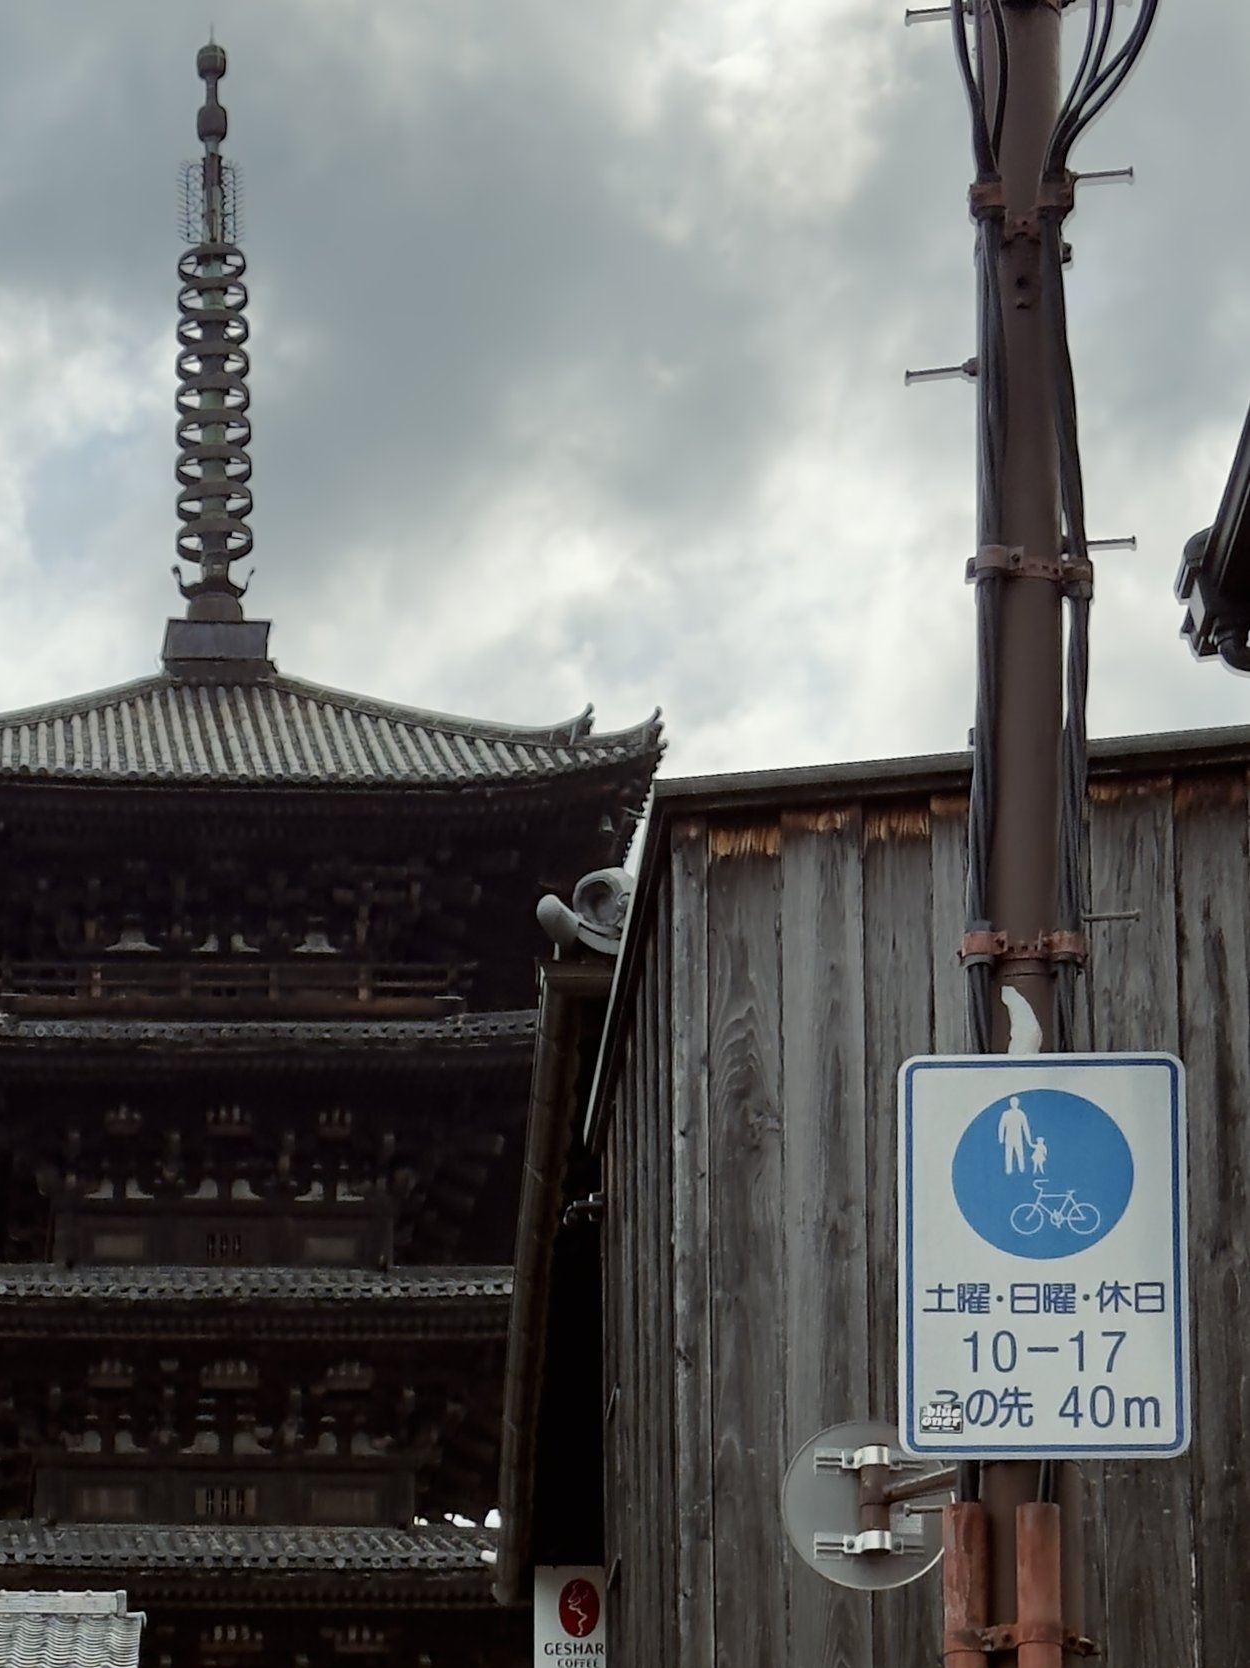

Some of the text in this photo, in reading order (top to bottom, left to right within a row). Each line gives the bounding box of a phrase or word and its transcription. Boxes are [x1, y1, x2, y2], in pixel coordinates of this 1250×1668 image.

[922, 1280, 1165, 1314] 土曜・日曜・休日
[557, 1658, 600, 1668] COFFEE
